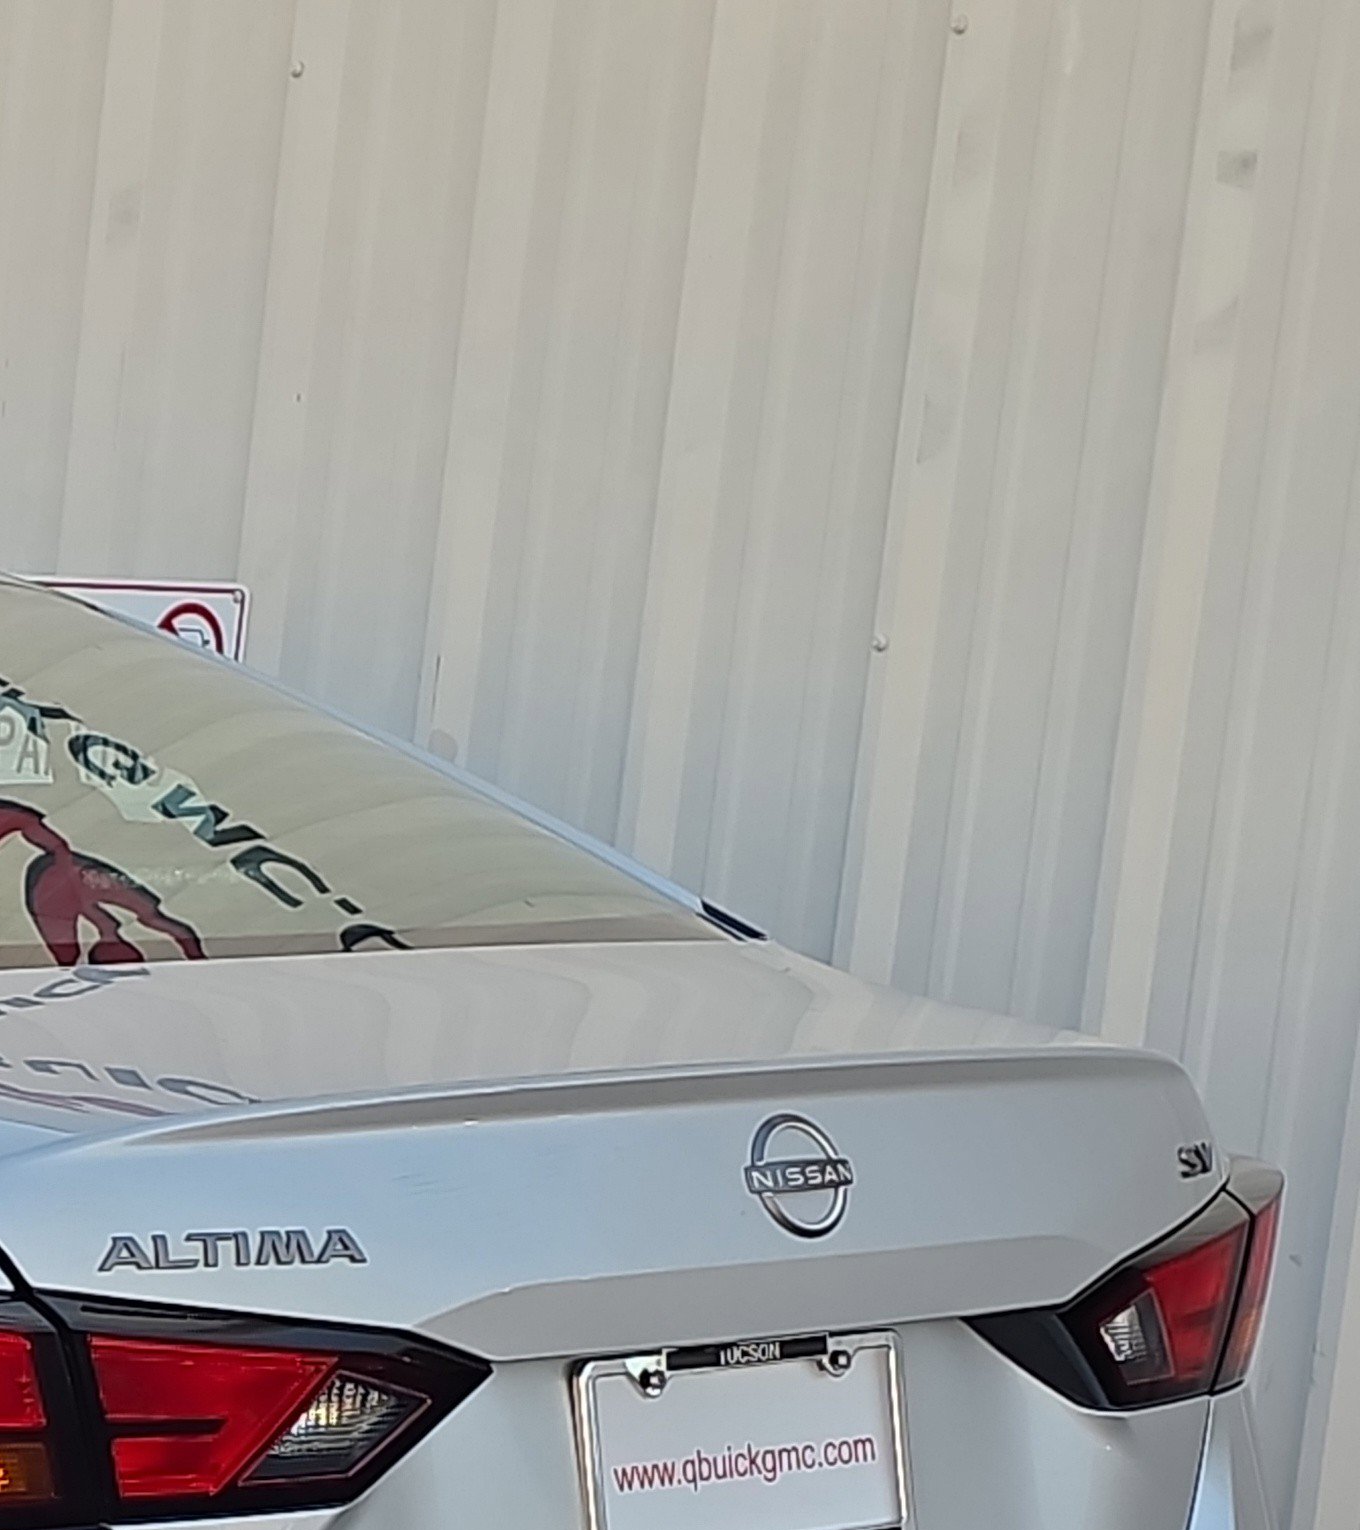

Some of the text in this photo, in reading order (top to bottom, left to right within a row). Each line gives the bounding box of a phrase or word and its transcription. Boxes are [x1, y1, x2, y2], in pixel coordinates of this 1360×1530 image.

[751, 1163, 852, 1188] NISSAN
[95, 1227, 368, 1272] ALTIMA
[613, 1436, 877, 1493] www.qbuickgmc.com
